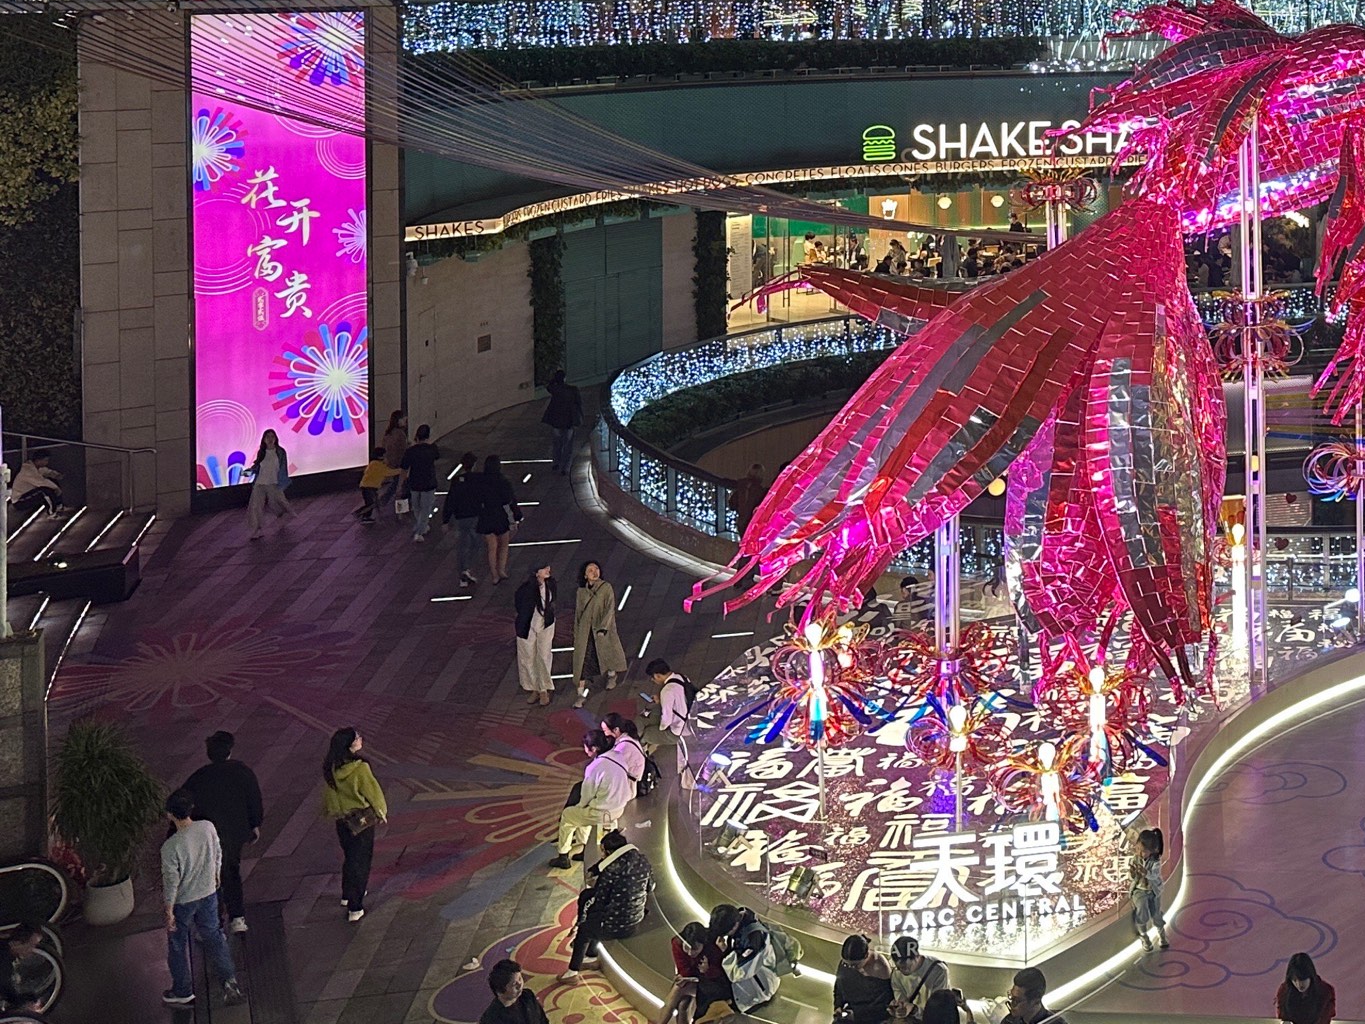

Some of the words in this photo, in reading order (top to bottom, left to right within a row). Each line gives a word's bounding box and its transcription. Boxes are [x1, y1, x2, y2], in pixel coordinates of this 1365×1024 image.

[912, 120, 1051, 160] SHAKE
[415, 221, 485, 240] SHAKES
[746, 168, 824, 183] CONCRETES
[831, 164, 881, 177] FLOATS
[882, 162, 930, 175] CONES
[936, 159, 995, 173] BURGERS
[1001, 157, 1050, 170] FROZEN
[888, 908, 956, 932] PARC
[965, 894, 1087, 924] CENTRAL
